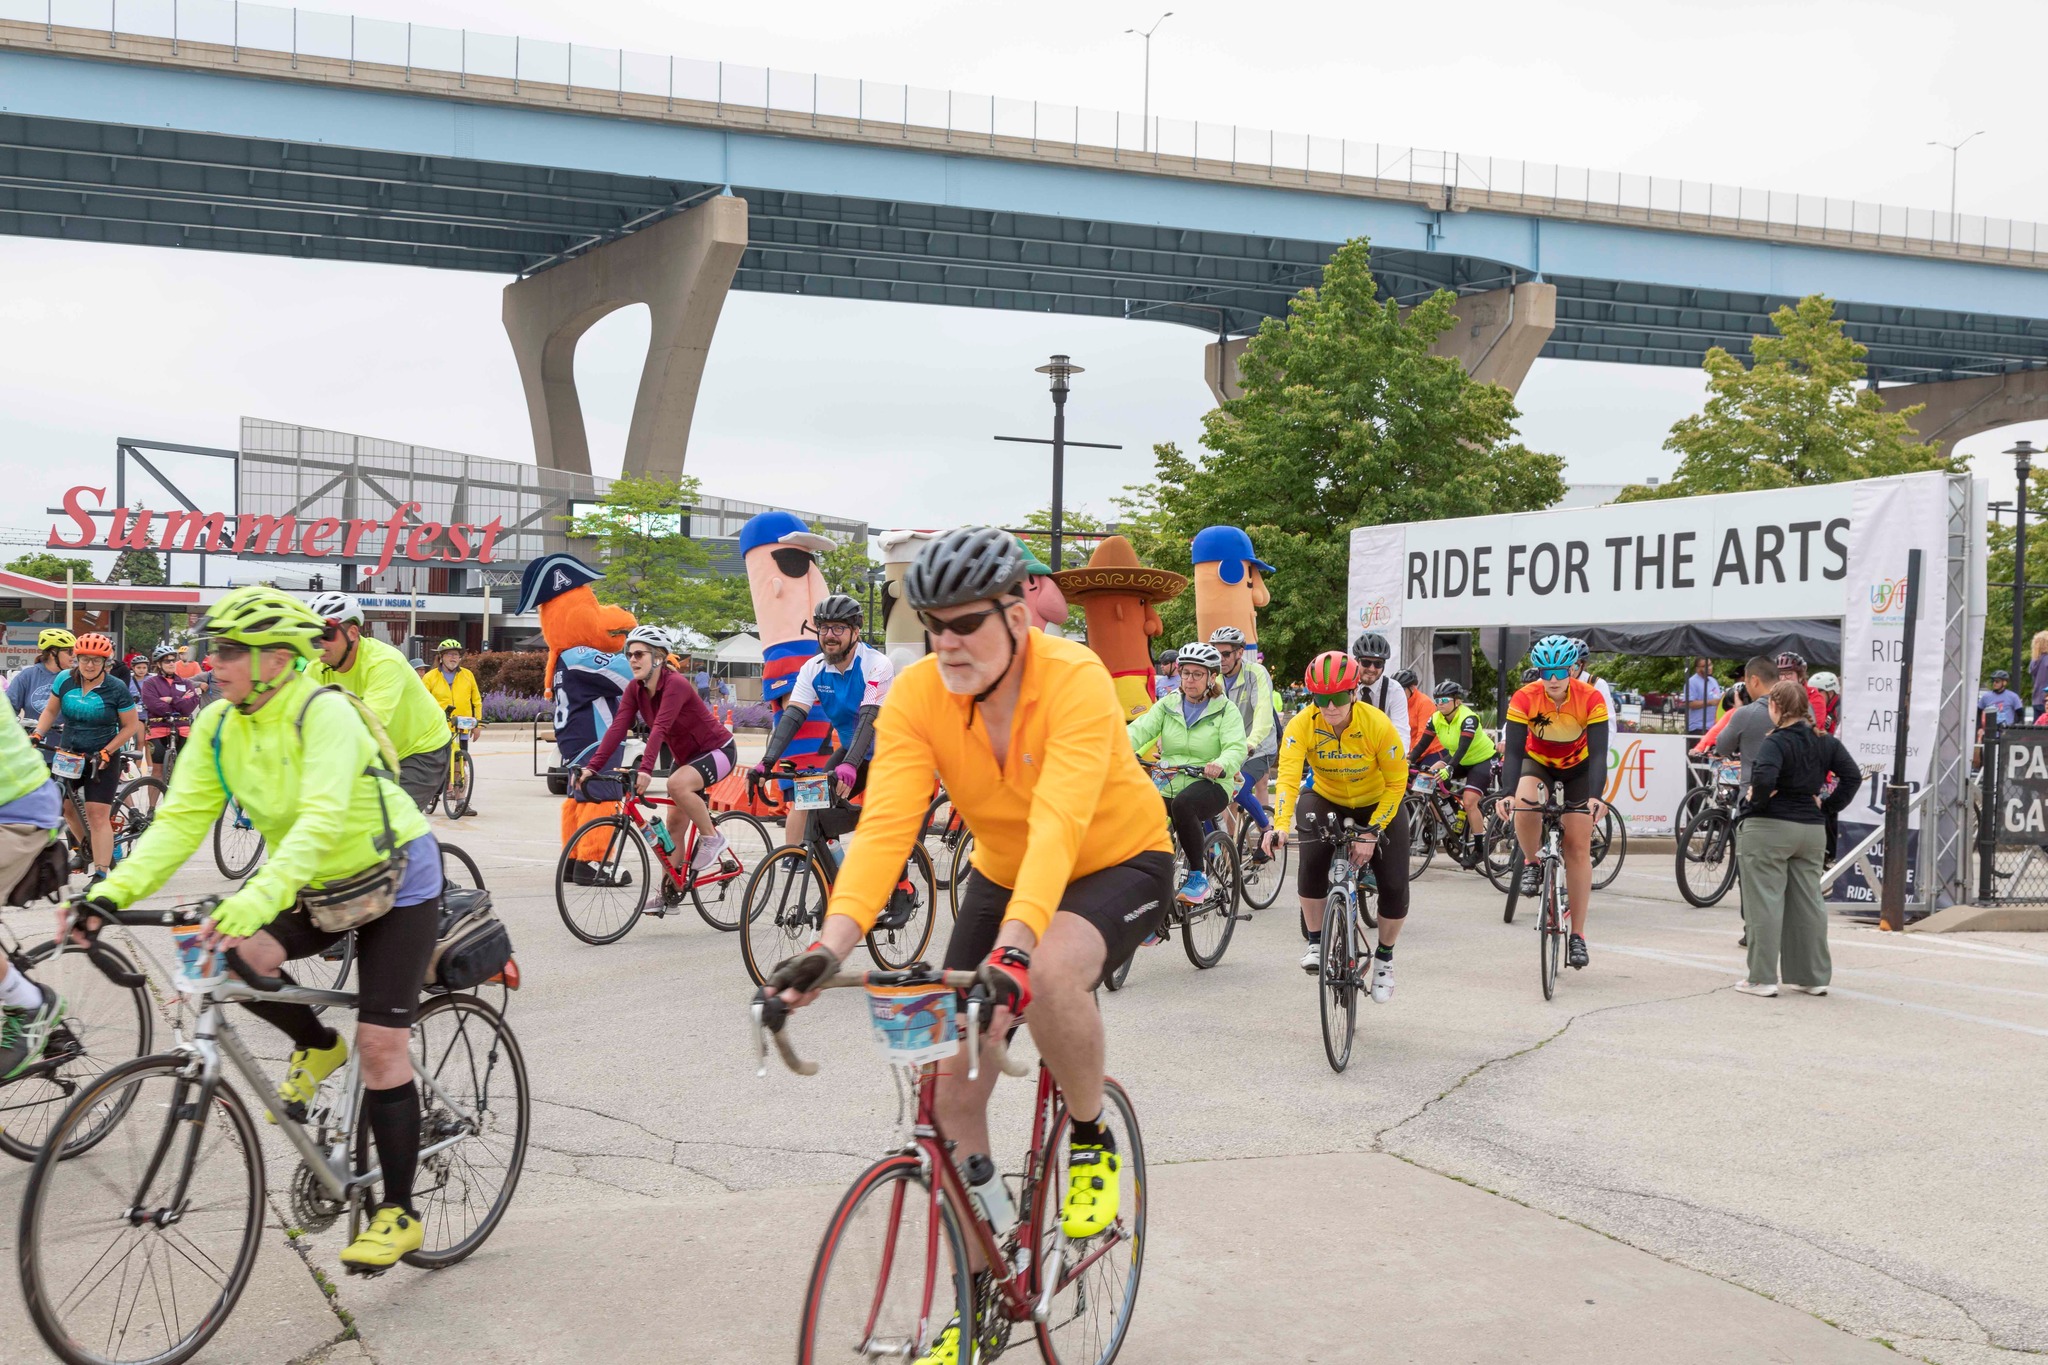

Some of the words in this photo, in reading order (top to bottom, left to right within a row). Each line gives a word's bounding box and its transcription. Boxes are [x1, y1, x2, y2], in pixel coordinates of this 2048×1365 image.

[48, 485, 505, 577] Summerfest
[1407, 545, 1493, 600] RIDE
[1507, 540, 1590, 597] FOR
[1605, 531, 1696, 592] THE
[1712, 517, 1851, 588] ARTS
[553, 568, 573, 592] A
[358, 598, 385, 607] FAMILY
[385, 598, 426, 608] INSURACE
[0, 646, 42, 654] Welcome
[1872, 640, 1904, 663] RID
[1867, 677, 1893, 692] FOR
[1867, 710, 1900, 733] ART
[1860, 743, 1897, 756] PRESENTE
[1905, 746, 1920, 757] BY
[2004, 797, 2048, 833] GA
[1846, 885, 1873, 902] RIDE
